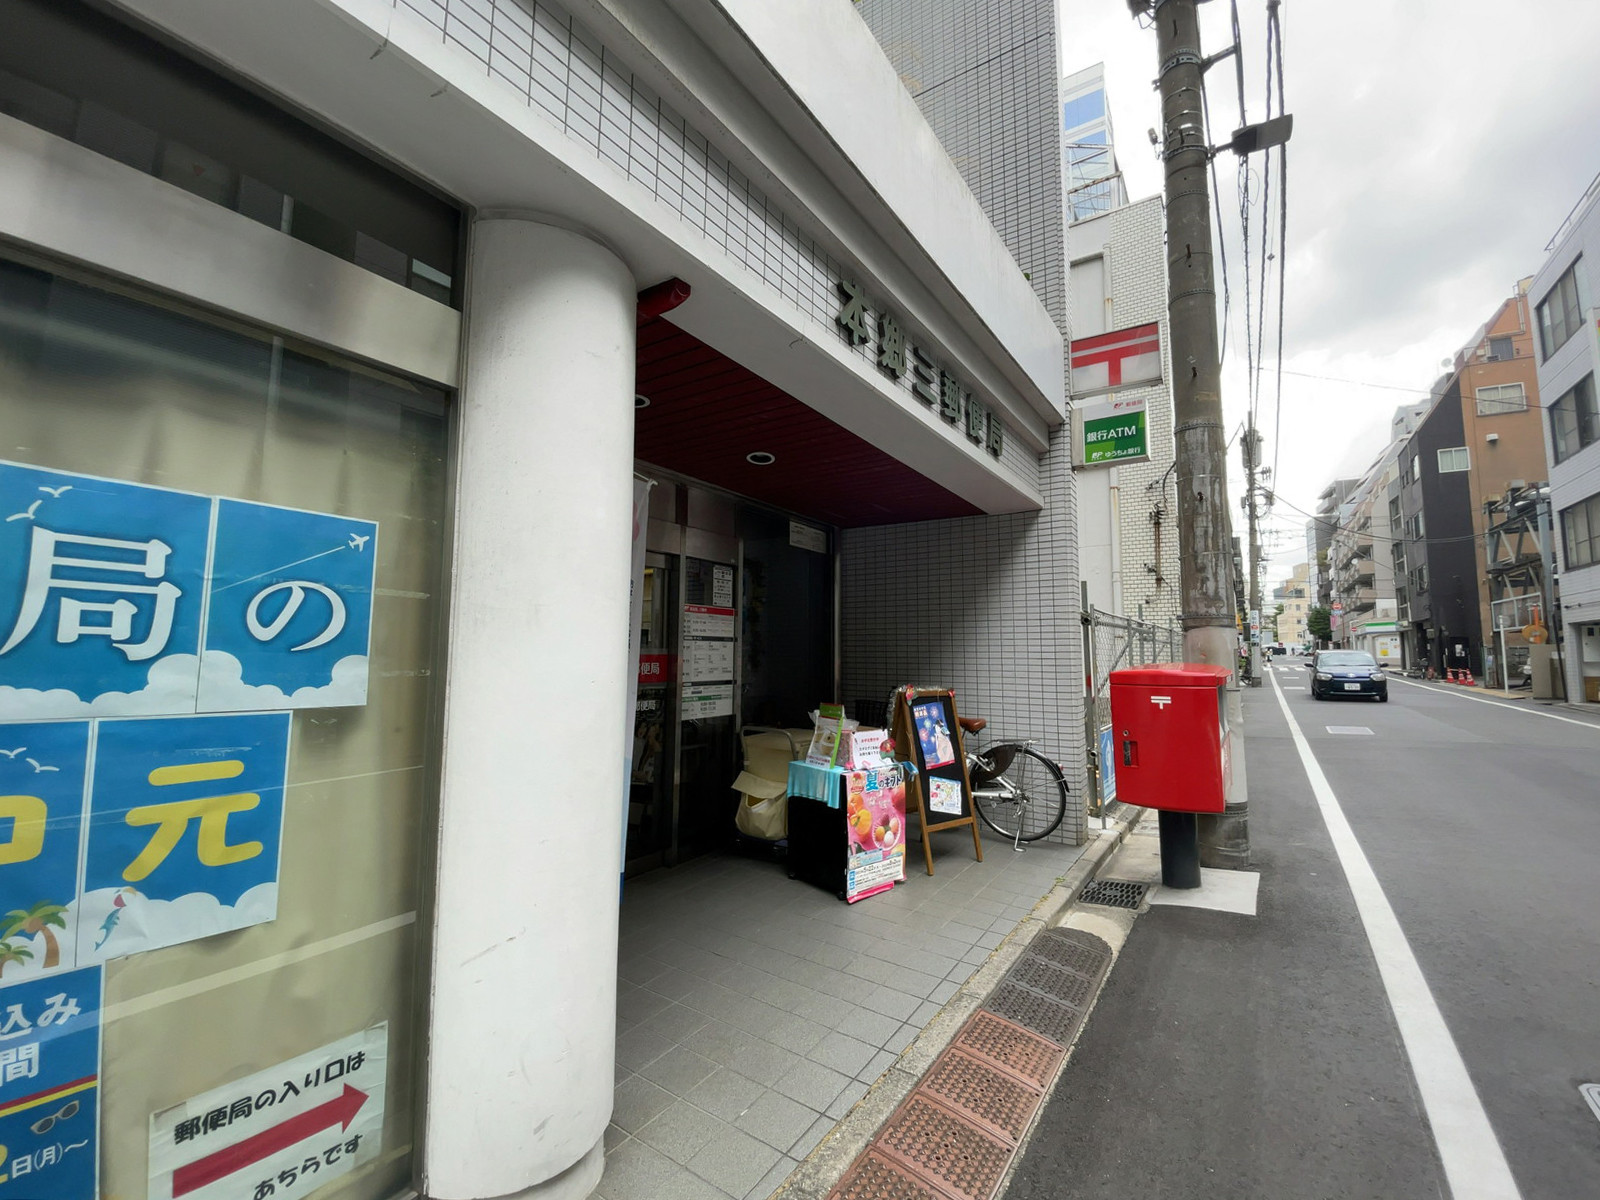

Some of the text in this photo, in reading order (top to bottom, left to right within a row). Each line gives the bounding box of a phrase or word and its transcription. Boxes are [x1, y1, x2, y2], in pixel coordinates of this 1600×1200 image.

[1086, 425, 1137, 443] 銀行ATM
[638, 662, 660, 675] 便局
[0, 1042, 40, 1087] 間
[174, 1051, 366, 1146] 郵便局の入り口は
[253, 1133, 364, 1200] あちらです
